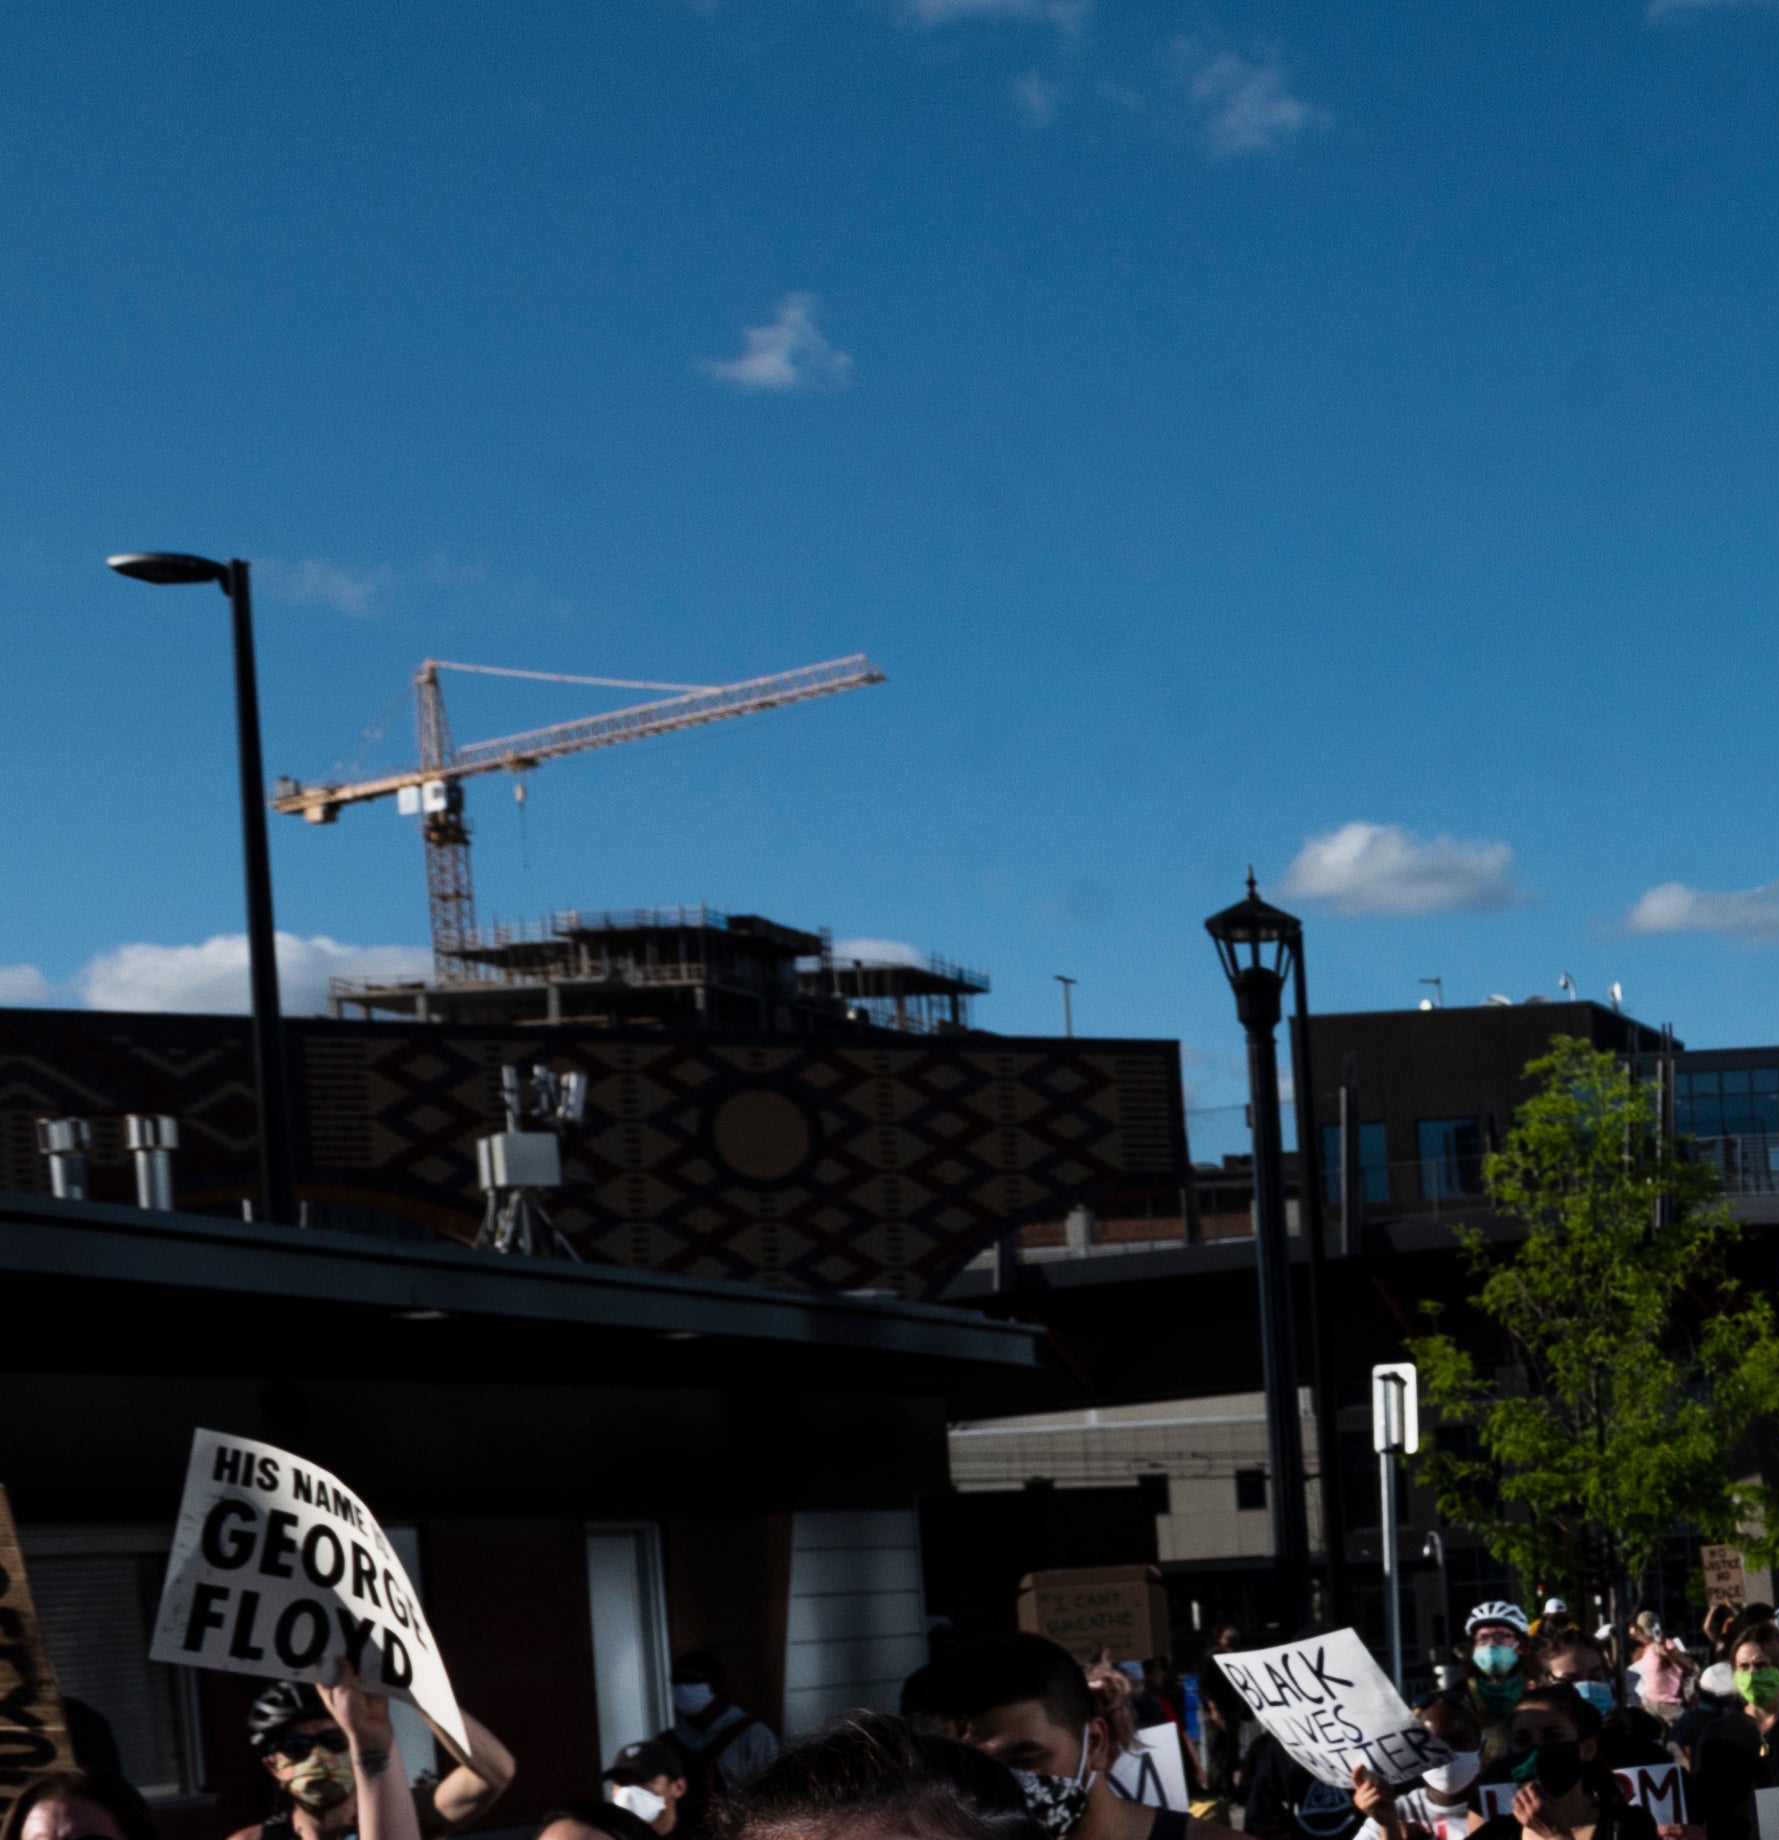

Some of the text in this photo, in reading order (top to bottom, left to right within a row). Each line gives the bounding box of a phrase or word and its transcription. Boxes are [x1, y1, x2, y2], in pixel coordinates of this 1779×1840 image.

[212, 1446, 280, 1493] HIS
[292, 1467, 368, 1537] NAME
[201, 1499, 428, 1653] GEORGE
[182, 1582, 414, 1690] FLOYD
[1225, 1646, 1355, 1711] BLACK
[1264, 1703, 1363, 1747] LIVES
